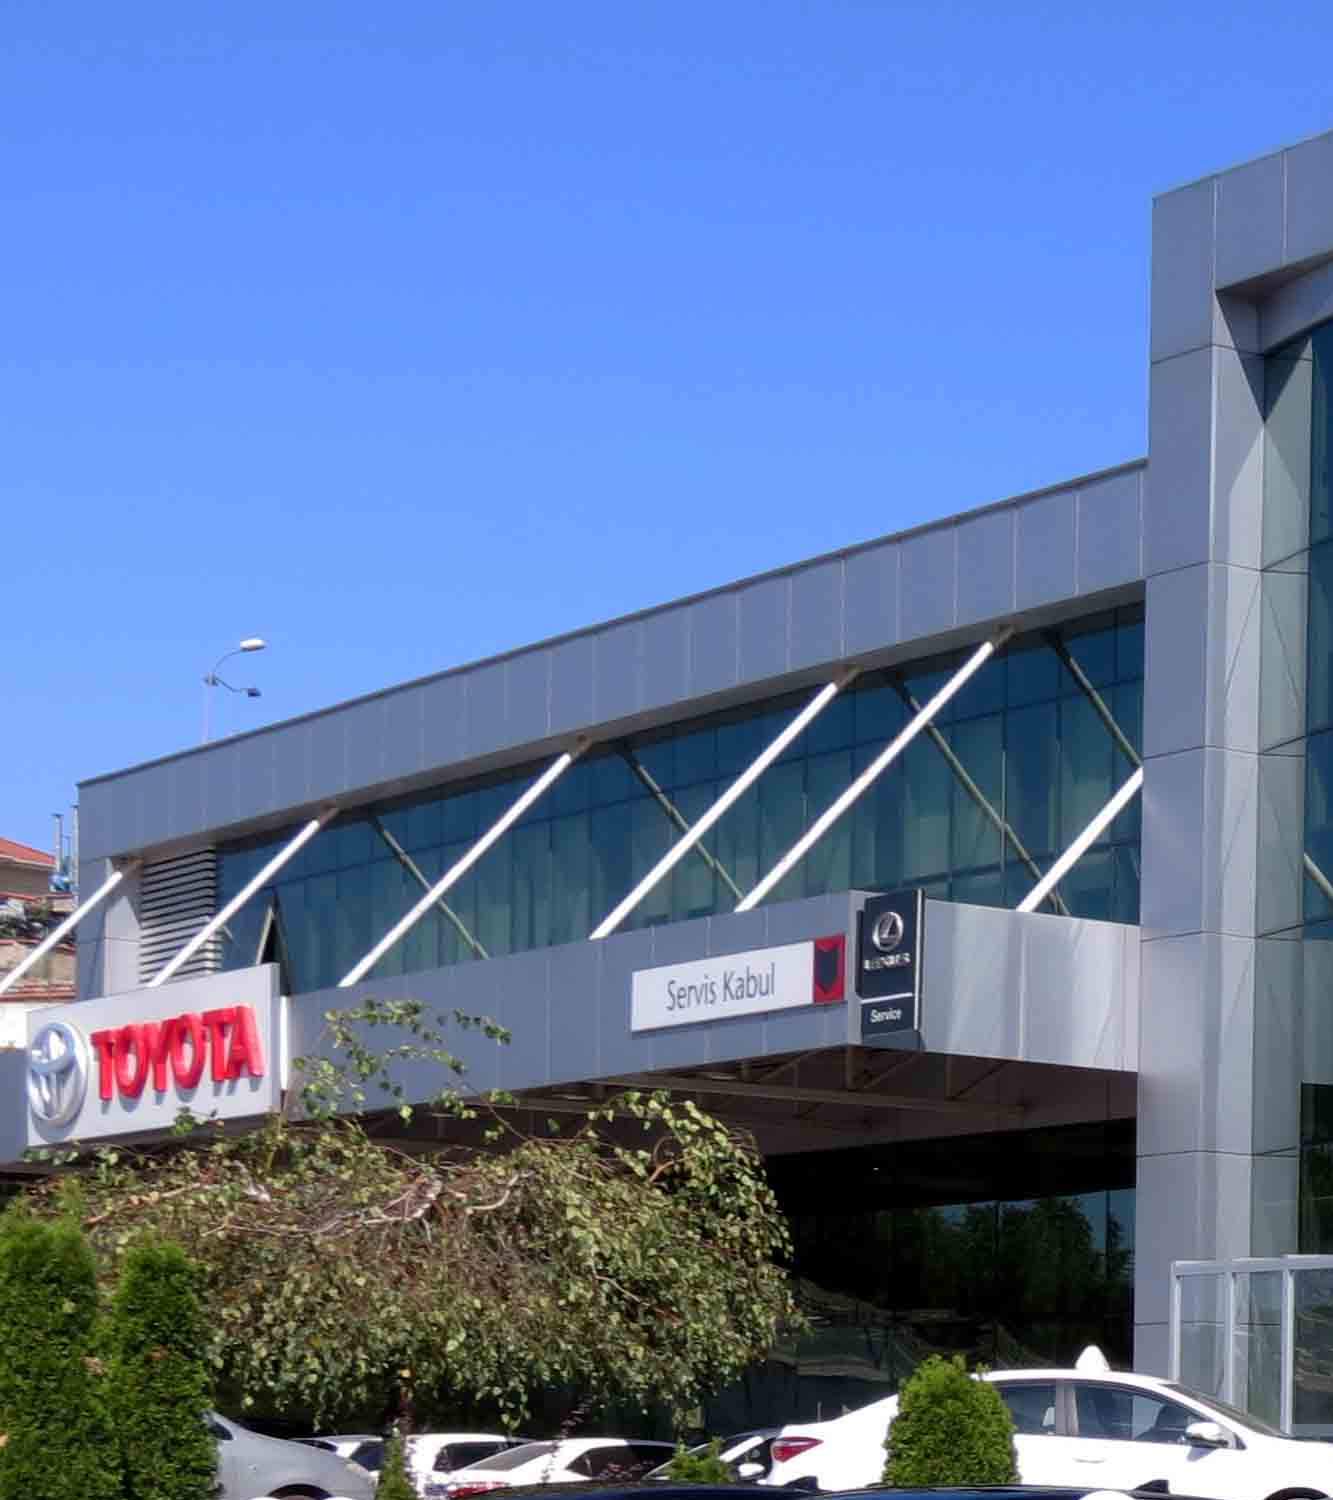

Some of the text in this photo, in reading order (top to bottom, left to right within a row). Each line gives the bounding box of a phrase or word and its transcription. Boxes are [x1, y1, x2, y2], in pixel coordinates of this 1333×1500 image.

[666, 961, 775, 1012] Servis Kabul
[869, 1007, 903, 1024] Service
[90, 1004, 265, 1101] TOYOTA
